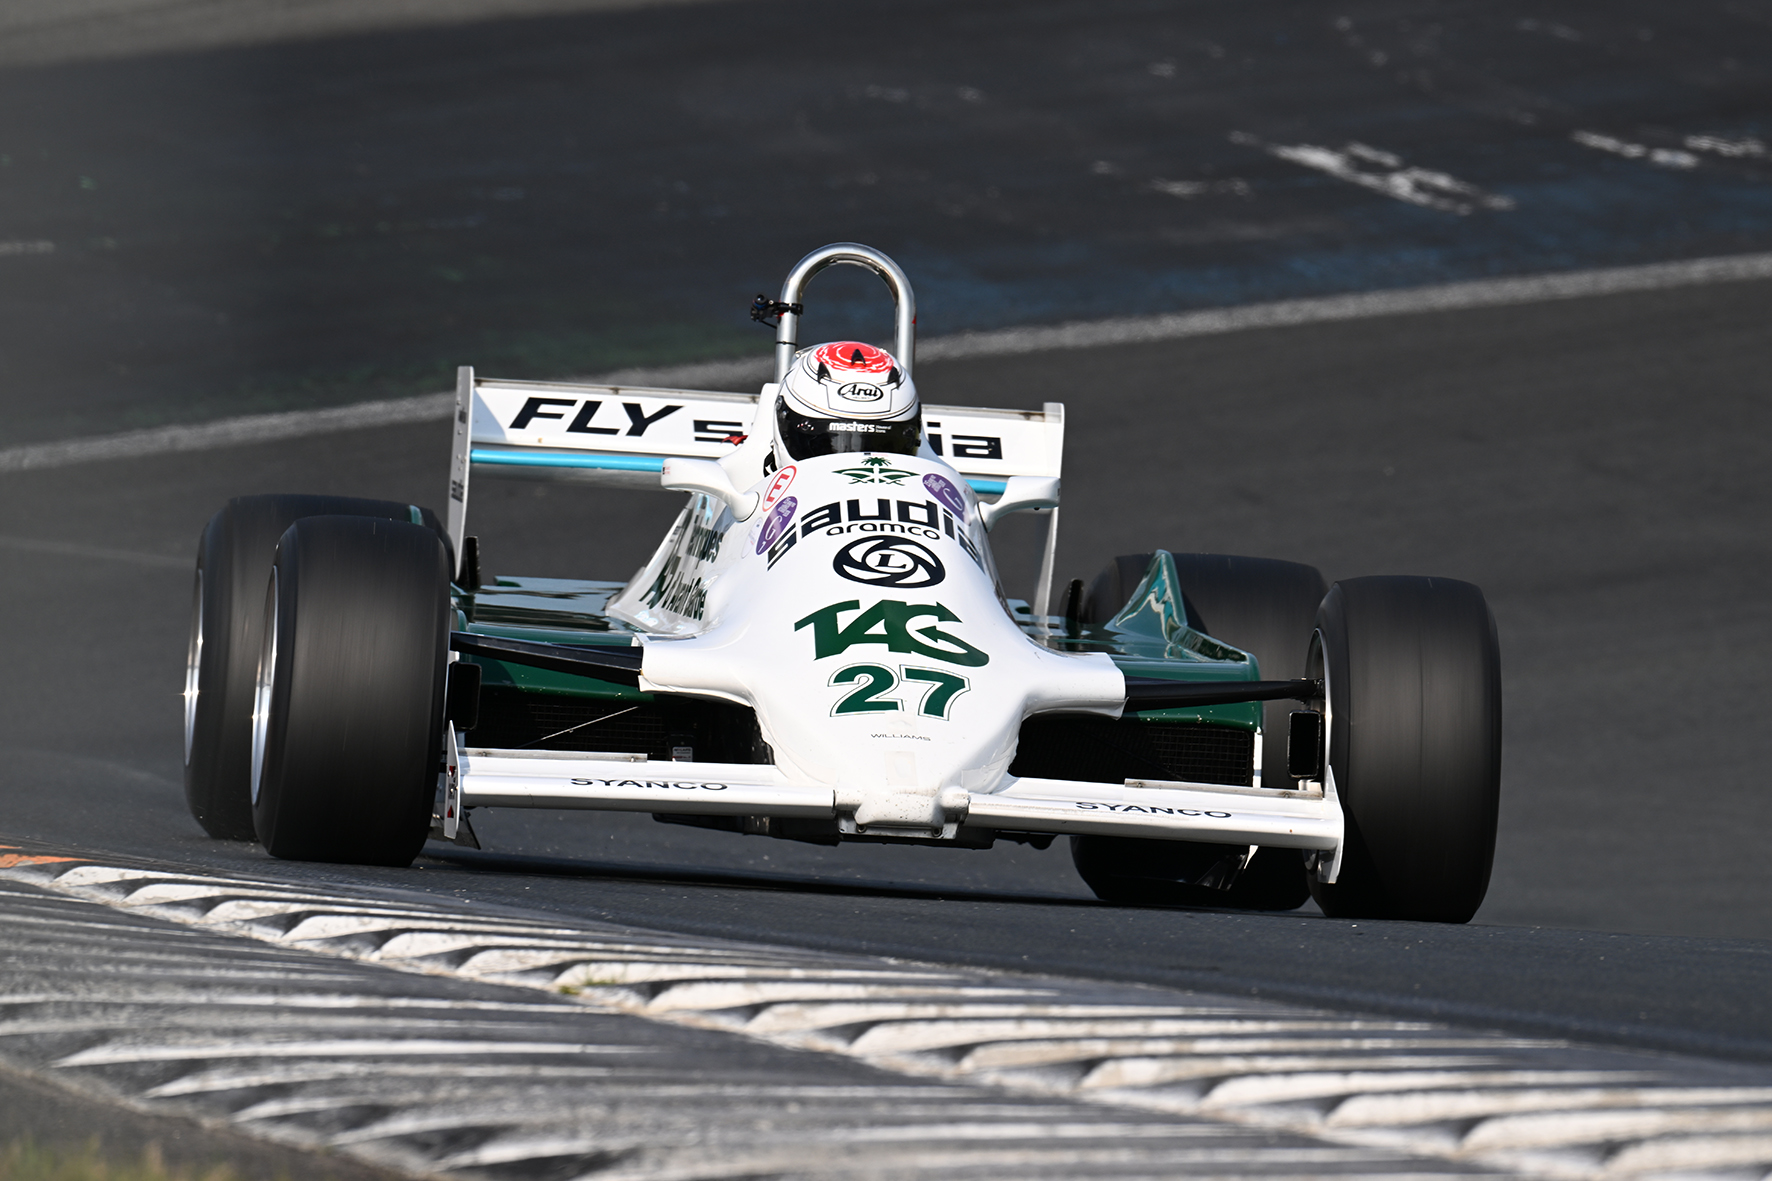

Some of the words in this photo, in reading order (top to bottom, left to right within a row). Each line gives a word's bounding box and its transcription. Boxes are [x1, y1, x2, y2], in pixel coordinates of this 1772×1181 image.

[841, 384, 878, 397] Arai
[509, 396, 684, 437] FLY
[829, 421, 875, 433] masters
[767, 498, 986, 575] saudia
[826, 522, 941, 540] aramco
[875, 553, 907, 570] L
[794, 599, 989, 667] TAG
[827, 662, 971, 721] 27
[870, 733, 931, 742] WILLIAMS
[571, 777, 728, 791] SYANCO
[1076, 801, 1232, 819] SYANCO
